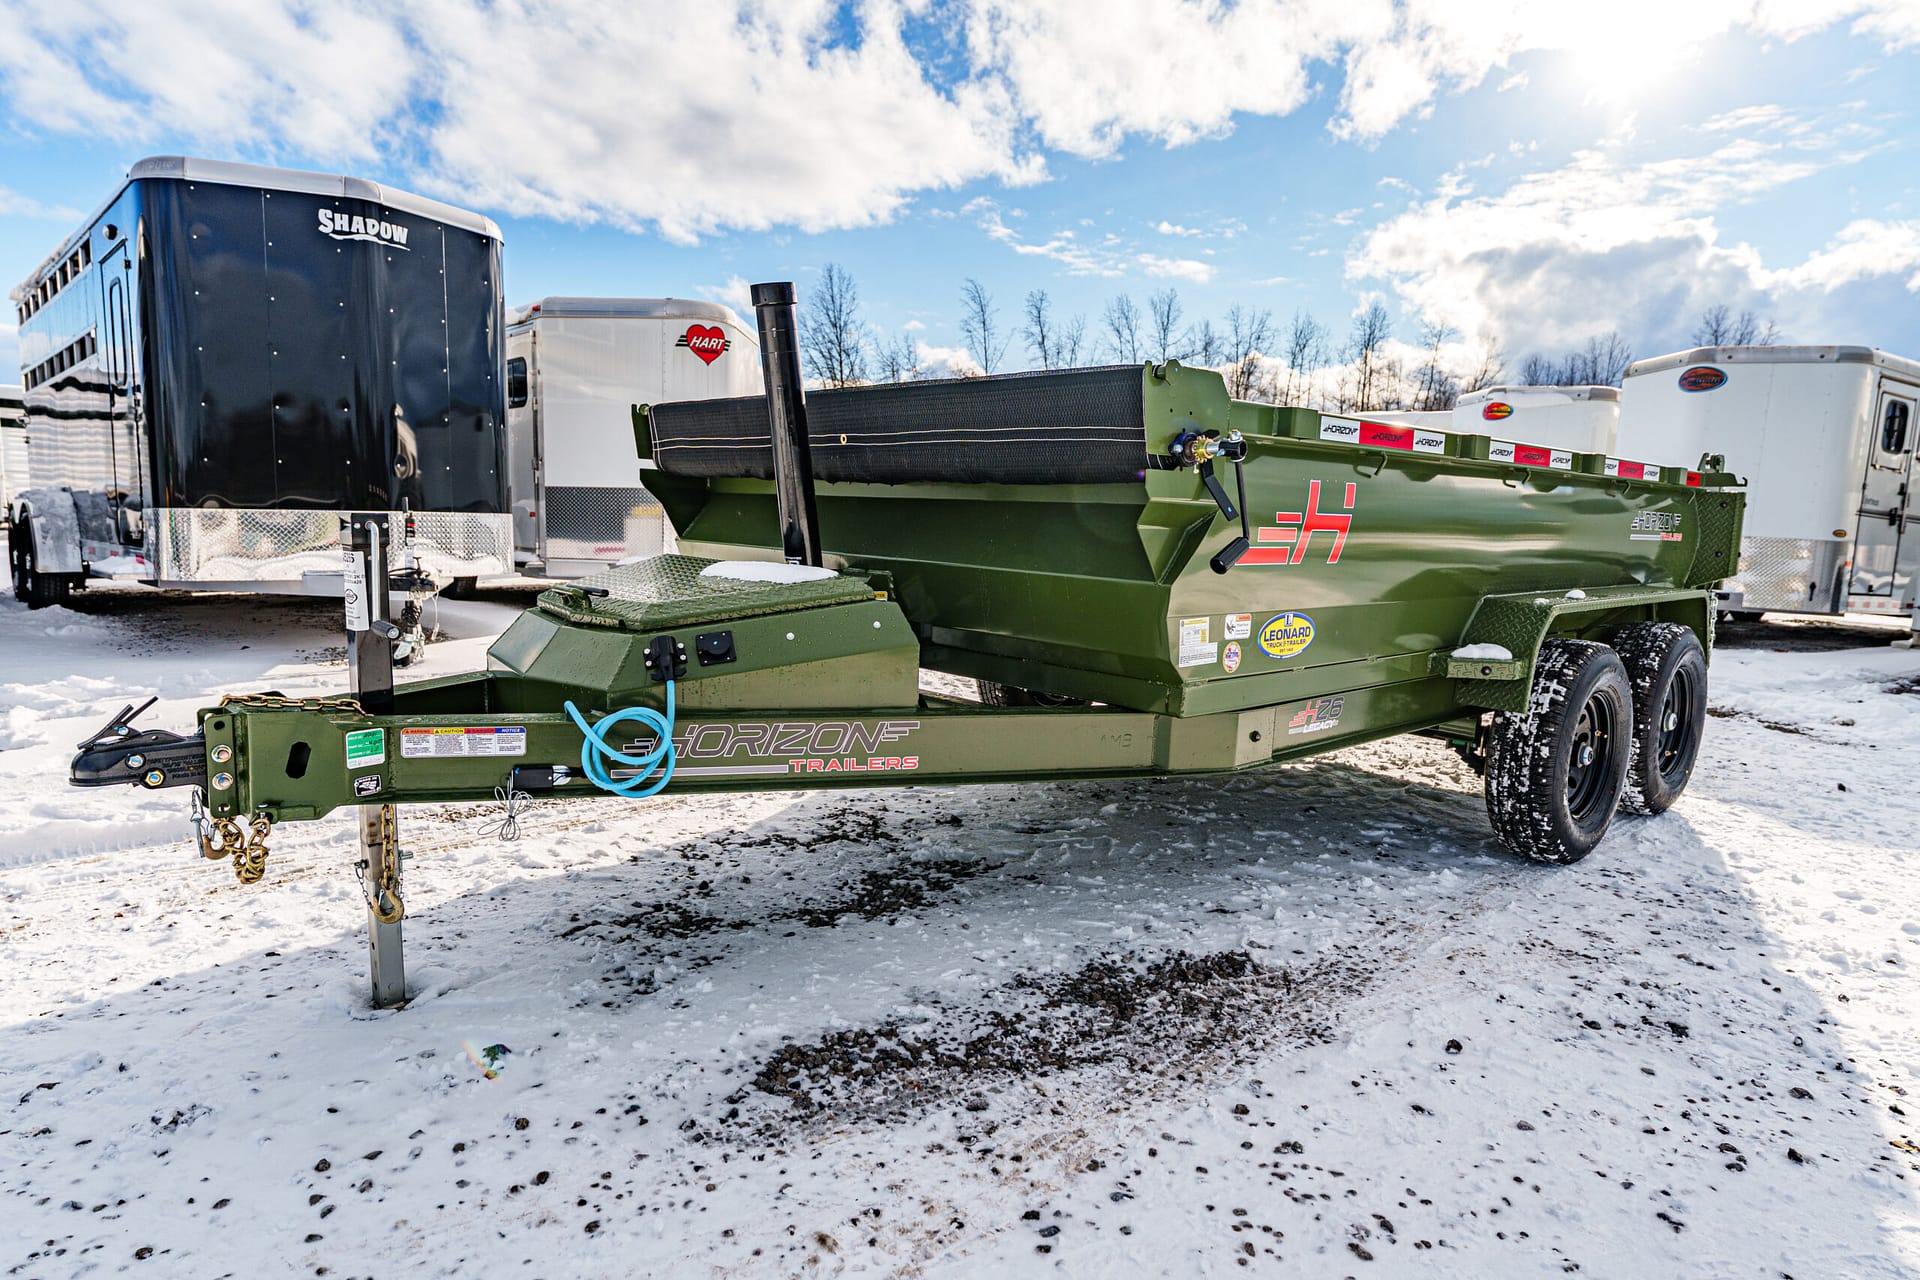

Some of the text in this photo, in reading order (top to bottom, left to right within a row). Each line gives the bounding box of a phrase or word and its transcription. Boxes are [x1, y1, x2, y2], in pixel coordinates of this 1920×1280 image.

[318, 208, 409, 244] SHADOW
[690, 336, 725, 350] HART
[1322, 424, 1359, 436] HORIZON
[1415, 437, 1444, 447] HORIZON
[1263, 626, 1311, 642] LEONARD
[1266, 640, 1283, 648] TRUCK
[789, 756, 919, 773] TRAILERS
